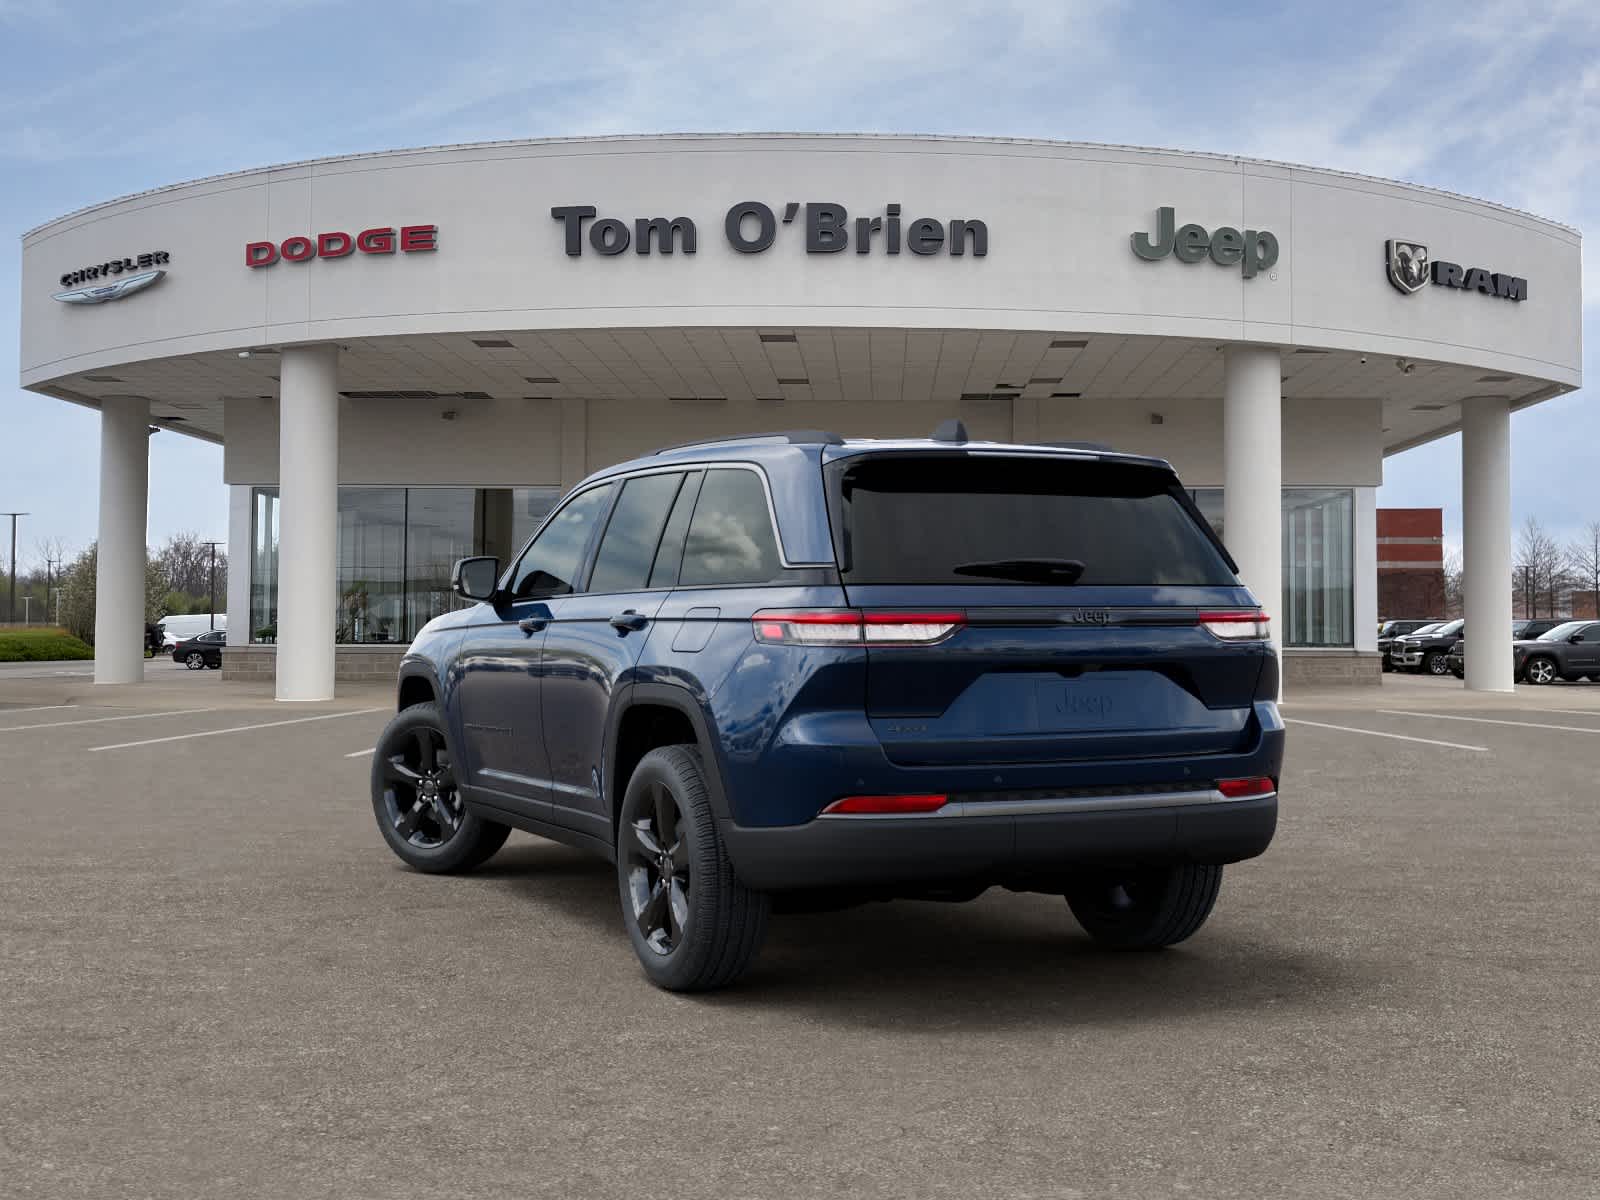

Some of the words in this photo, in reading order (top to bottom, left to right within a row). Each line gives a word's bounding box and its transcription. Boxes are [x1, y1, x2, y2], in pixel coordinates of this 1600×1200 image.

[246, 225, 438, 268] DODGE
[551, 205, 697, 256] Tom
[725, 201, 988, 256] O'Brien
[1130, 207, 1279, 279] Jeep
[60, 251, 169, 287] CHRYSLER
[1431, 261, 1527, 301] RAM
[1072, 607, 1112, 625] Jeep
[1056, 687, 1113, 719] Jeep
